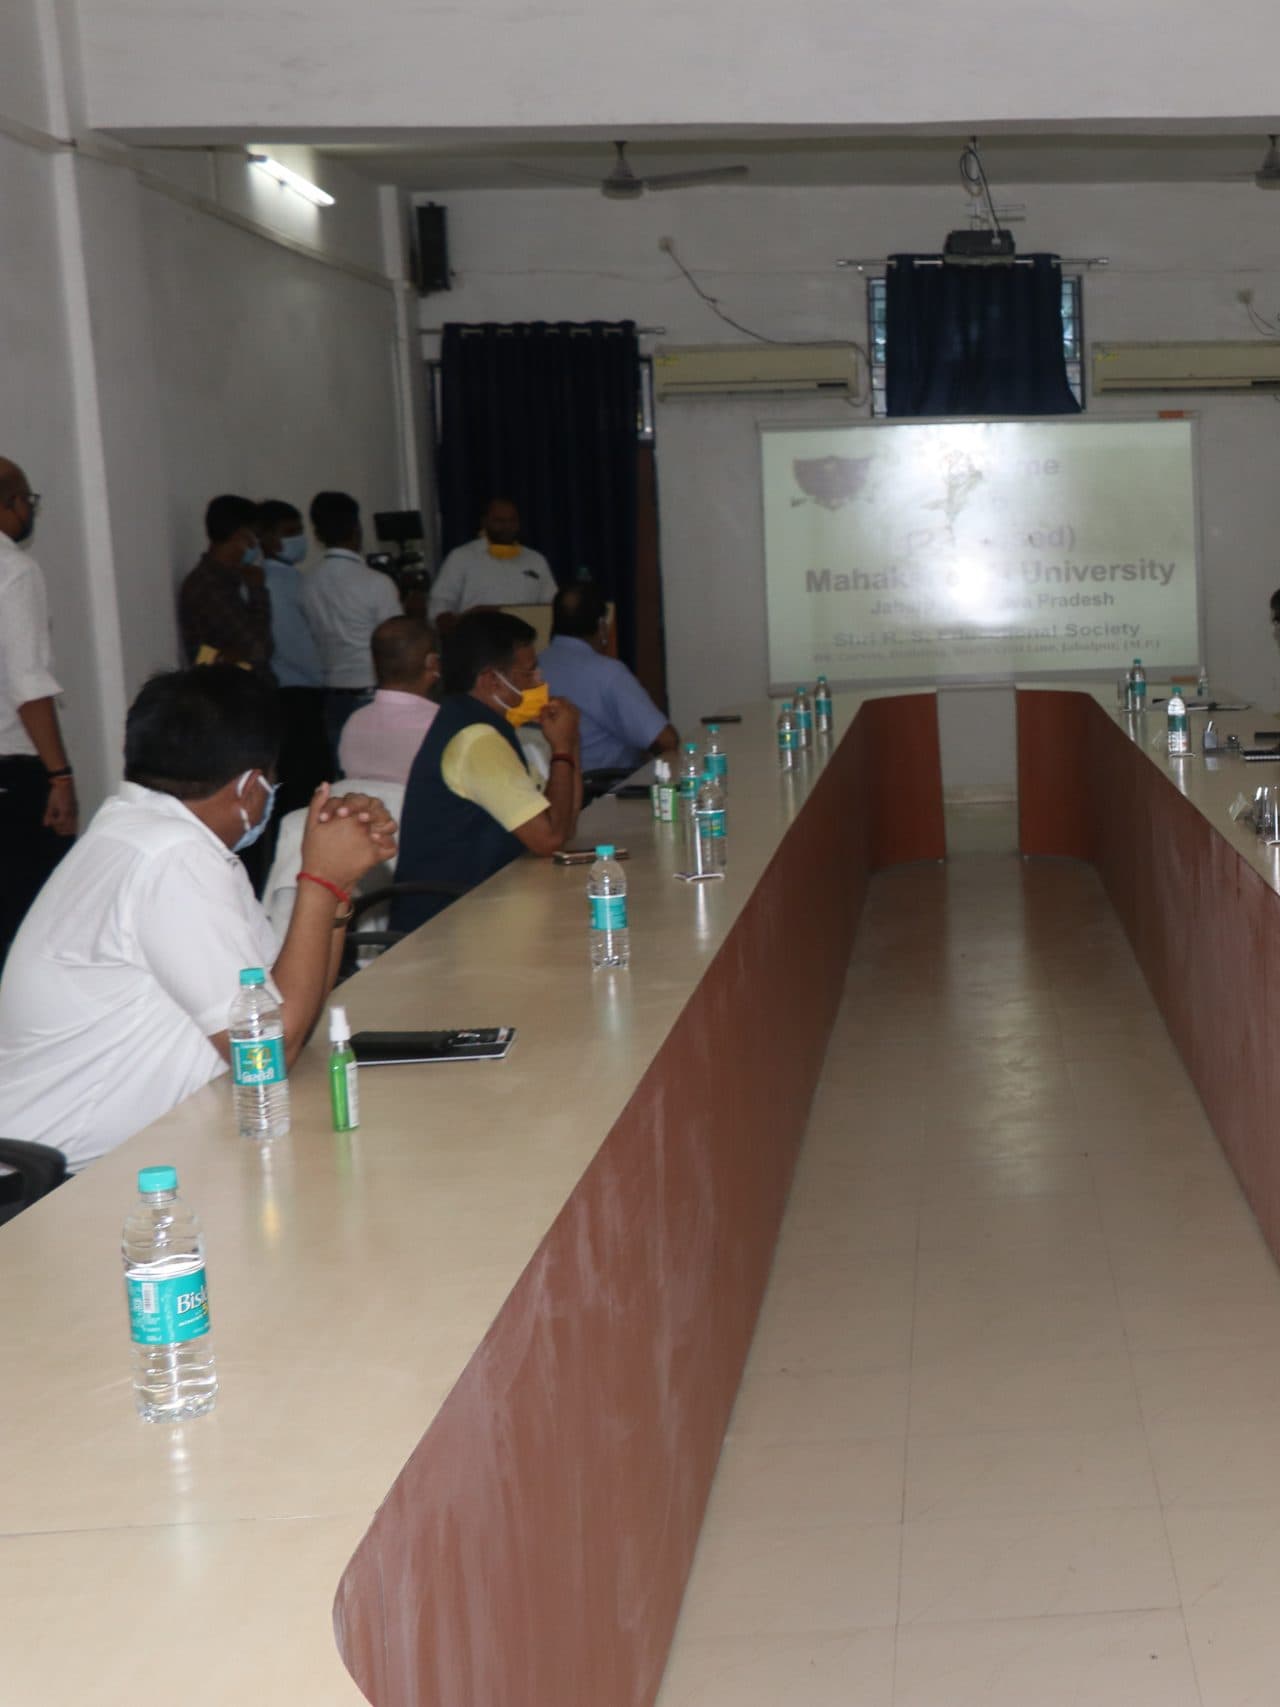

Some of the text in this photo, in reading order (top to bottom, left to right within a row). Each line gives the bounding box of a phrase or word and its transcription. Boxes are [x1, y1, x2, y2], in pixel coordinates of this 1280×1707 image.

[1020, 557, 1176, 587] University
[1037, 591, 1115, 609] Pradesh
[1063, 622, 1142, 640] Society
